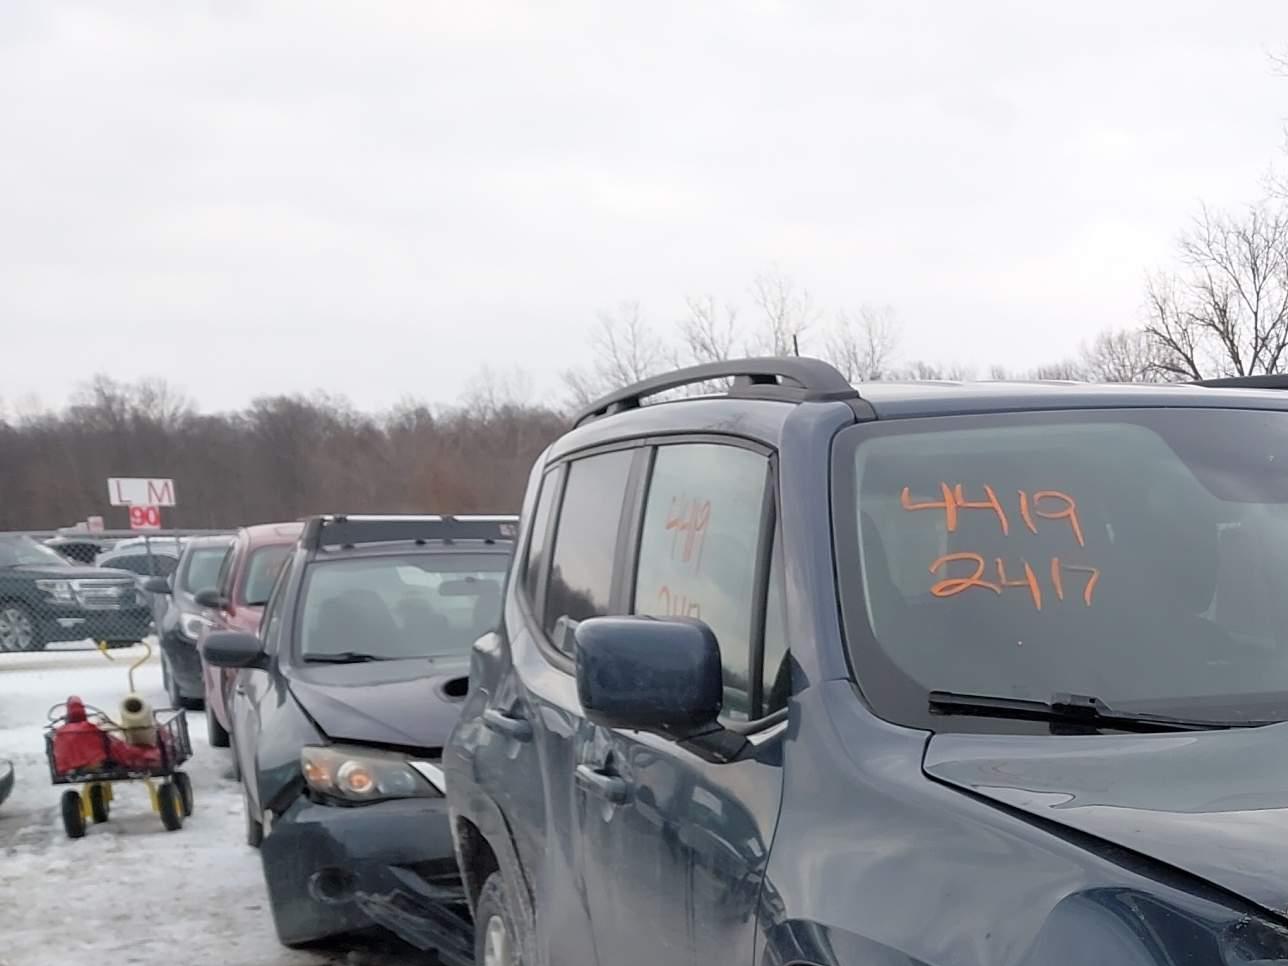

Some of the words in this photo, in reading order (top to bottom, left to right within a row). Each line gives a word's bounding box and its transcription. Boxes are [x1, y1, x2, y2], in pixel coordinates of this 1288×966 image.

[116, 480, 132, 502] L
[147, 480, 172, 503] M
[131, 506, 160, 526] 90
[901, 482, 1083, 547] 4419
[929, 552, 1100, 611] 2417
